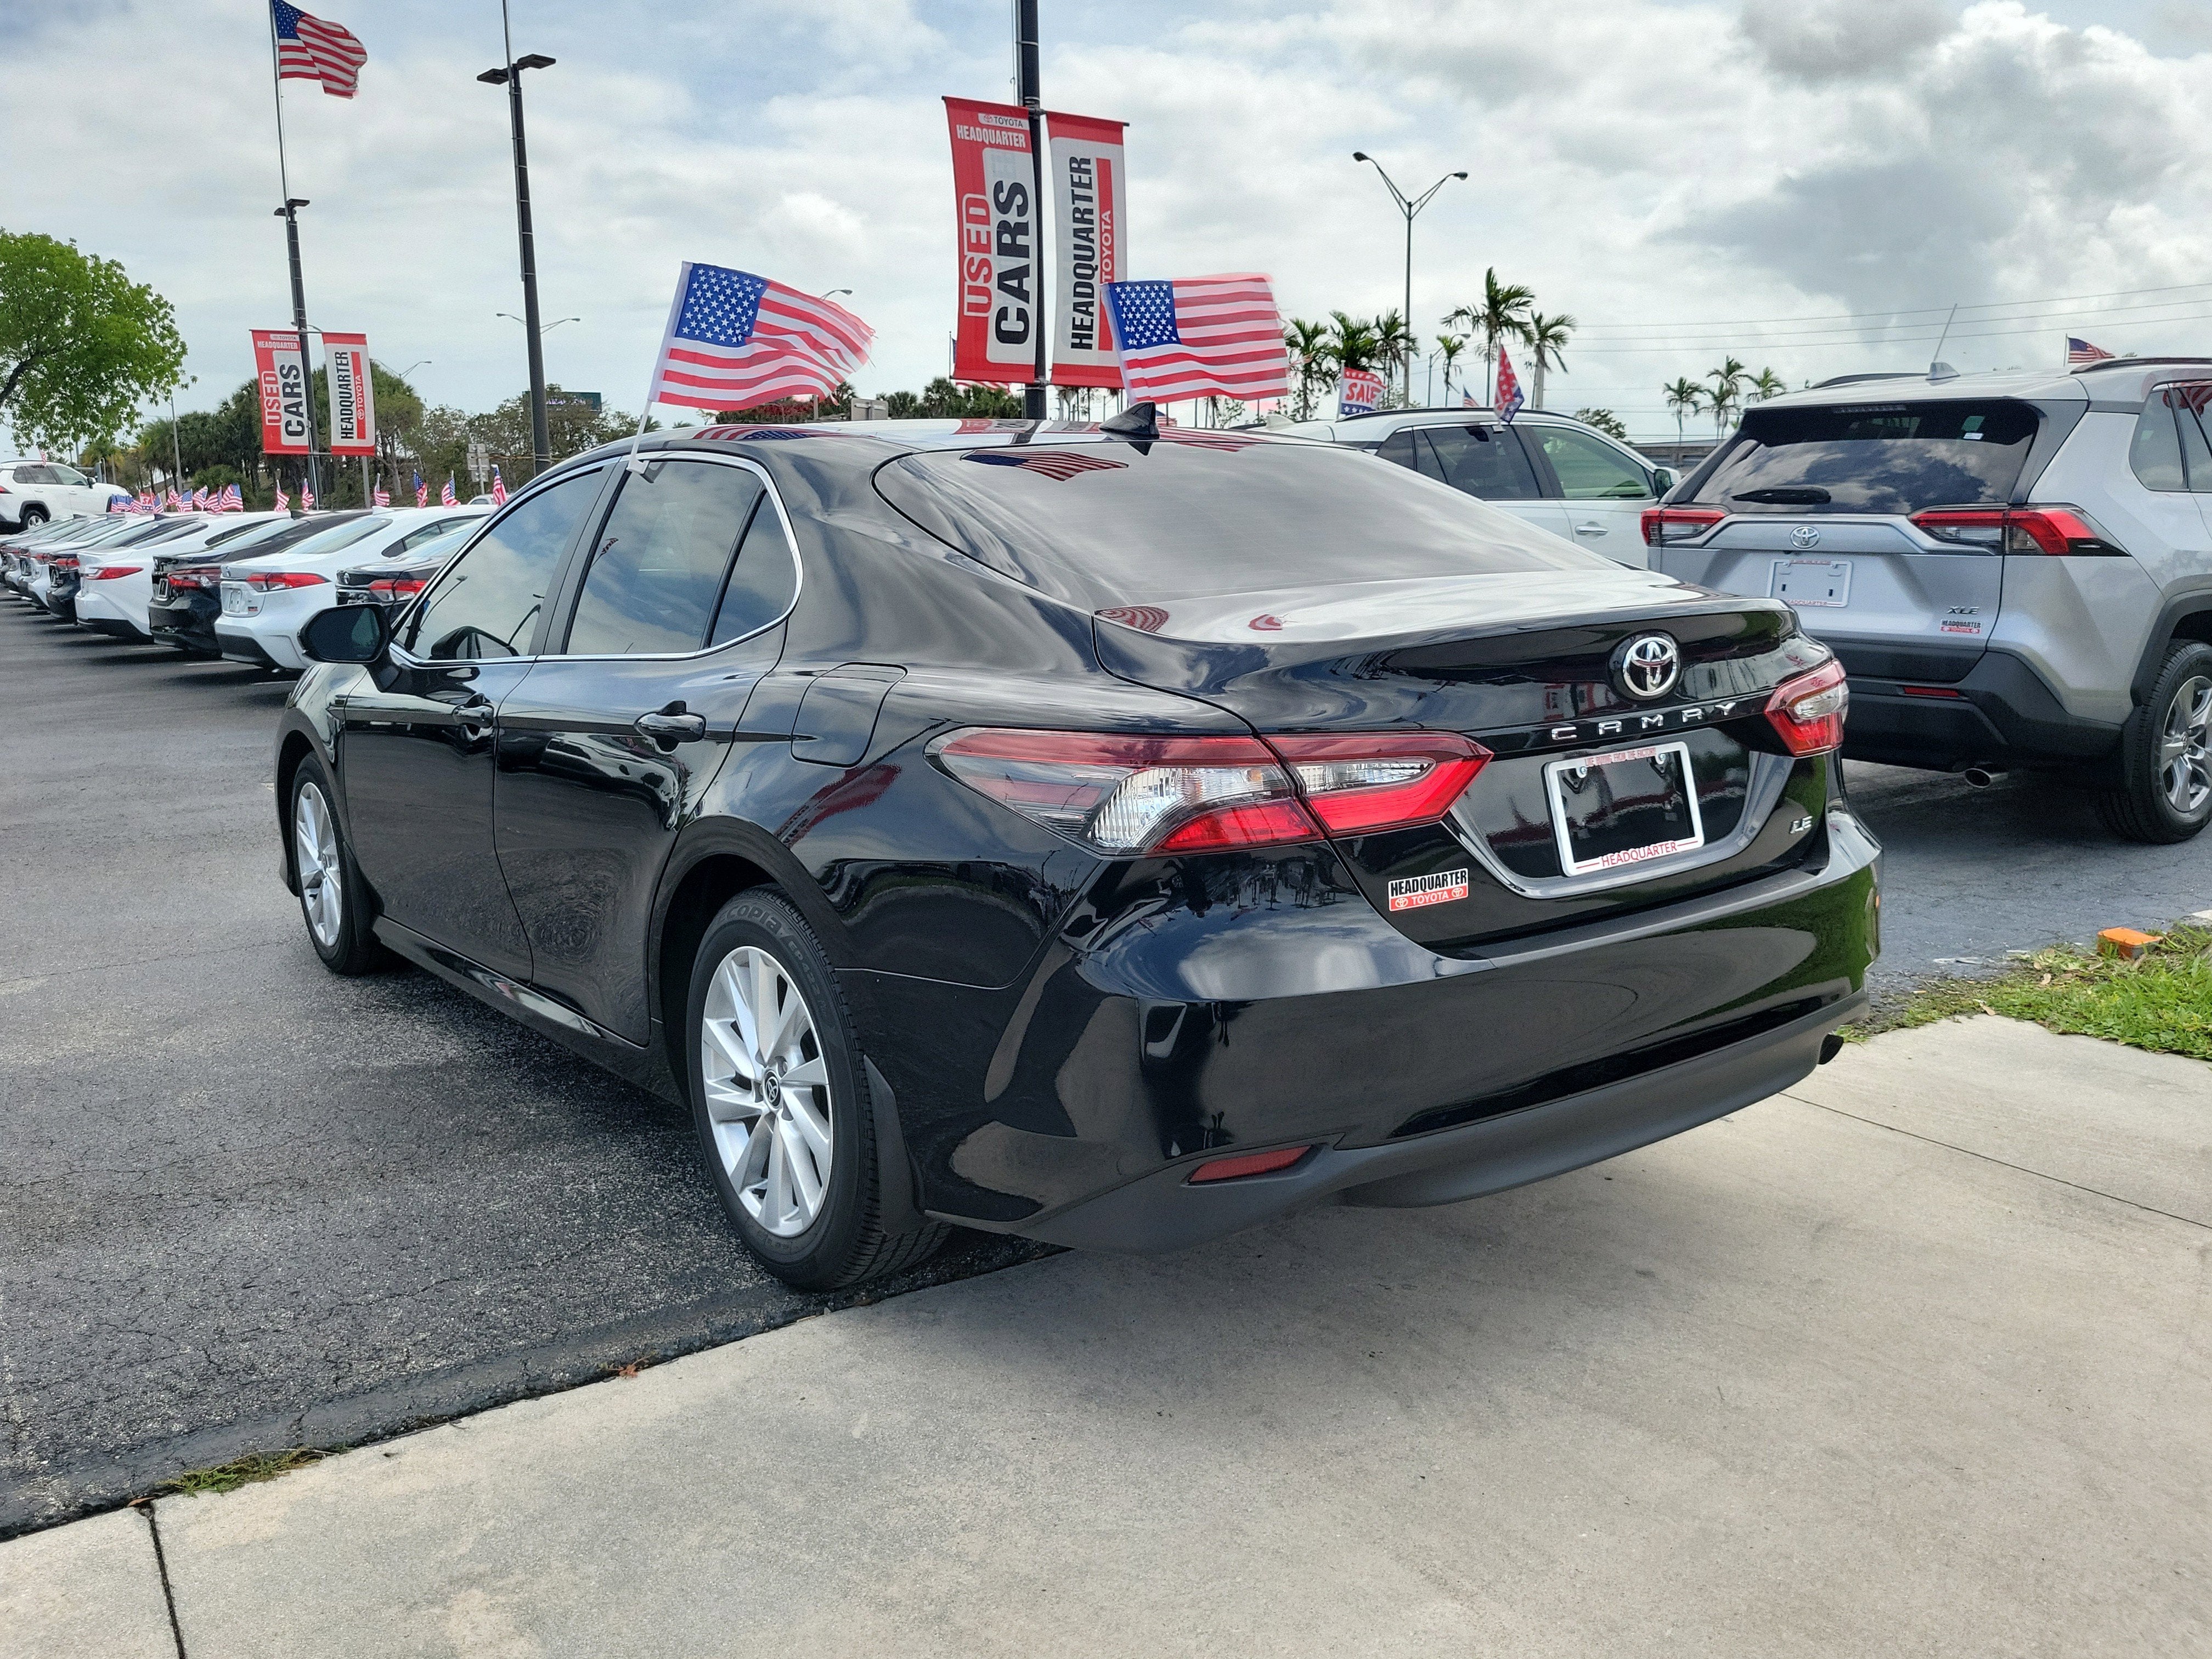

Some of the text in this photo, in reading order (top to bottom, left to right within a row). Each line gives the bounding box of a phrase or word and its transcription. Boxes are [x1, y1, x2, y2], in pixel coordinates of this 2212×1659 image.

[956, 125, 1026, 148] HEADQUARTER
[994, 116, 1023, 128] TOYOTA
[962, 194, 992, 317] USED
[1069, 156, 1098, 350] HEADQUARTER
[1101, 210, 1112, 283] TOYOTA
[994, 180, 1029, 345] CARS
[257, 341, 298, 349] HEADQUARTER
[262, 371, 281, 425] USED
[280, 364, 306, 437] CARS
[335, 352, 354, 439] HEADQUARTER
[356, 375, 364, 410] TOYOTA
[1942, 620, 1981, 629] HEADQUARTER
[1946, 606, 1979, 614] XLE
[1551, 702, 1737, 740] CAMRY
[1790, 816, 1813, 834] LE
[1602, 842, 1678, 867] HEADQUARTER
[1391, 870, 1467, 897] HEADQUARTER
[1412, 892, 1449, 905] TOYOTA
